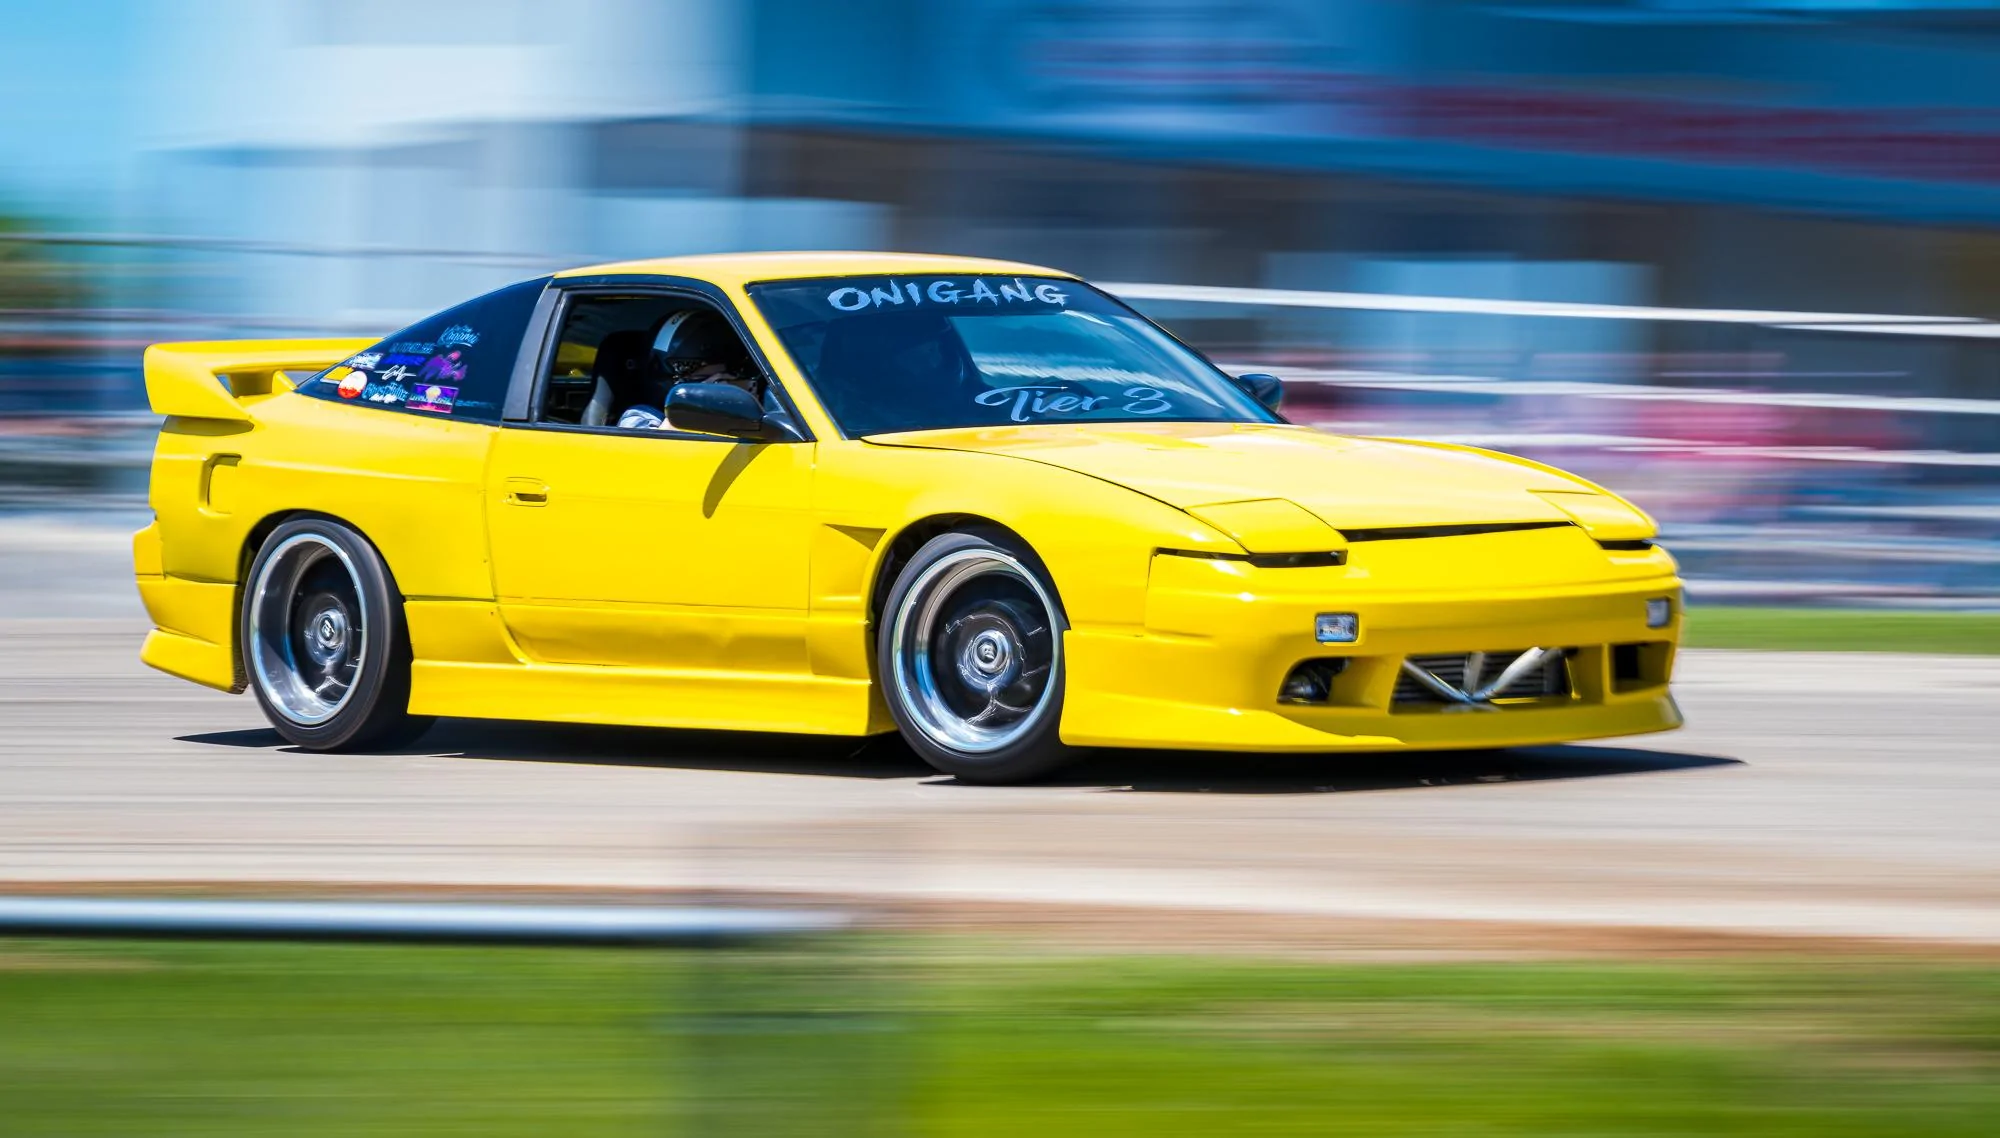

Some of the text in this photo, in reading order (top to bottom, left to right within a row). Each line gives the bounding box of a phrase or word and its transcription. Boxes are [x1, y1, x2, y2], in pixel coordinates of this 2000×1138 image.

[827, 278, 1070, 311] ONIGANG
[974, 386, 1172, 422] Tier 3
